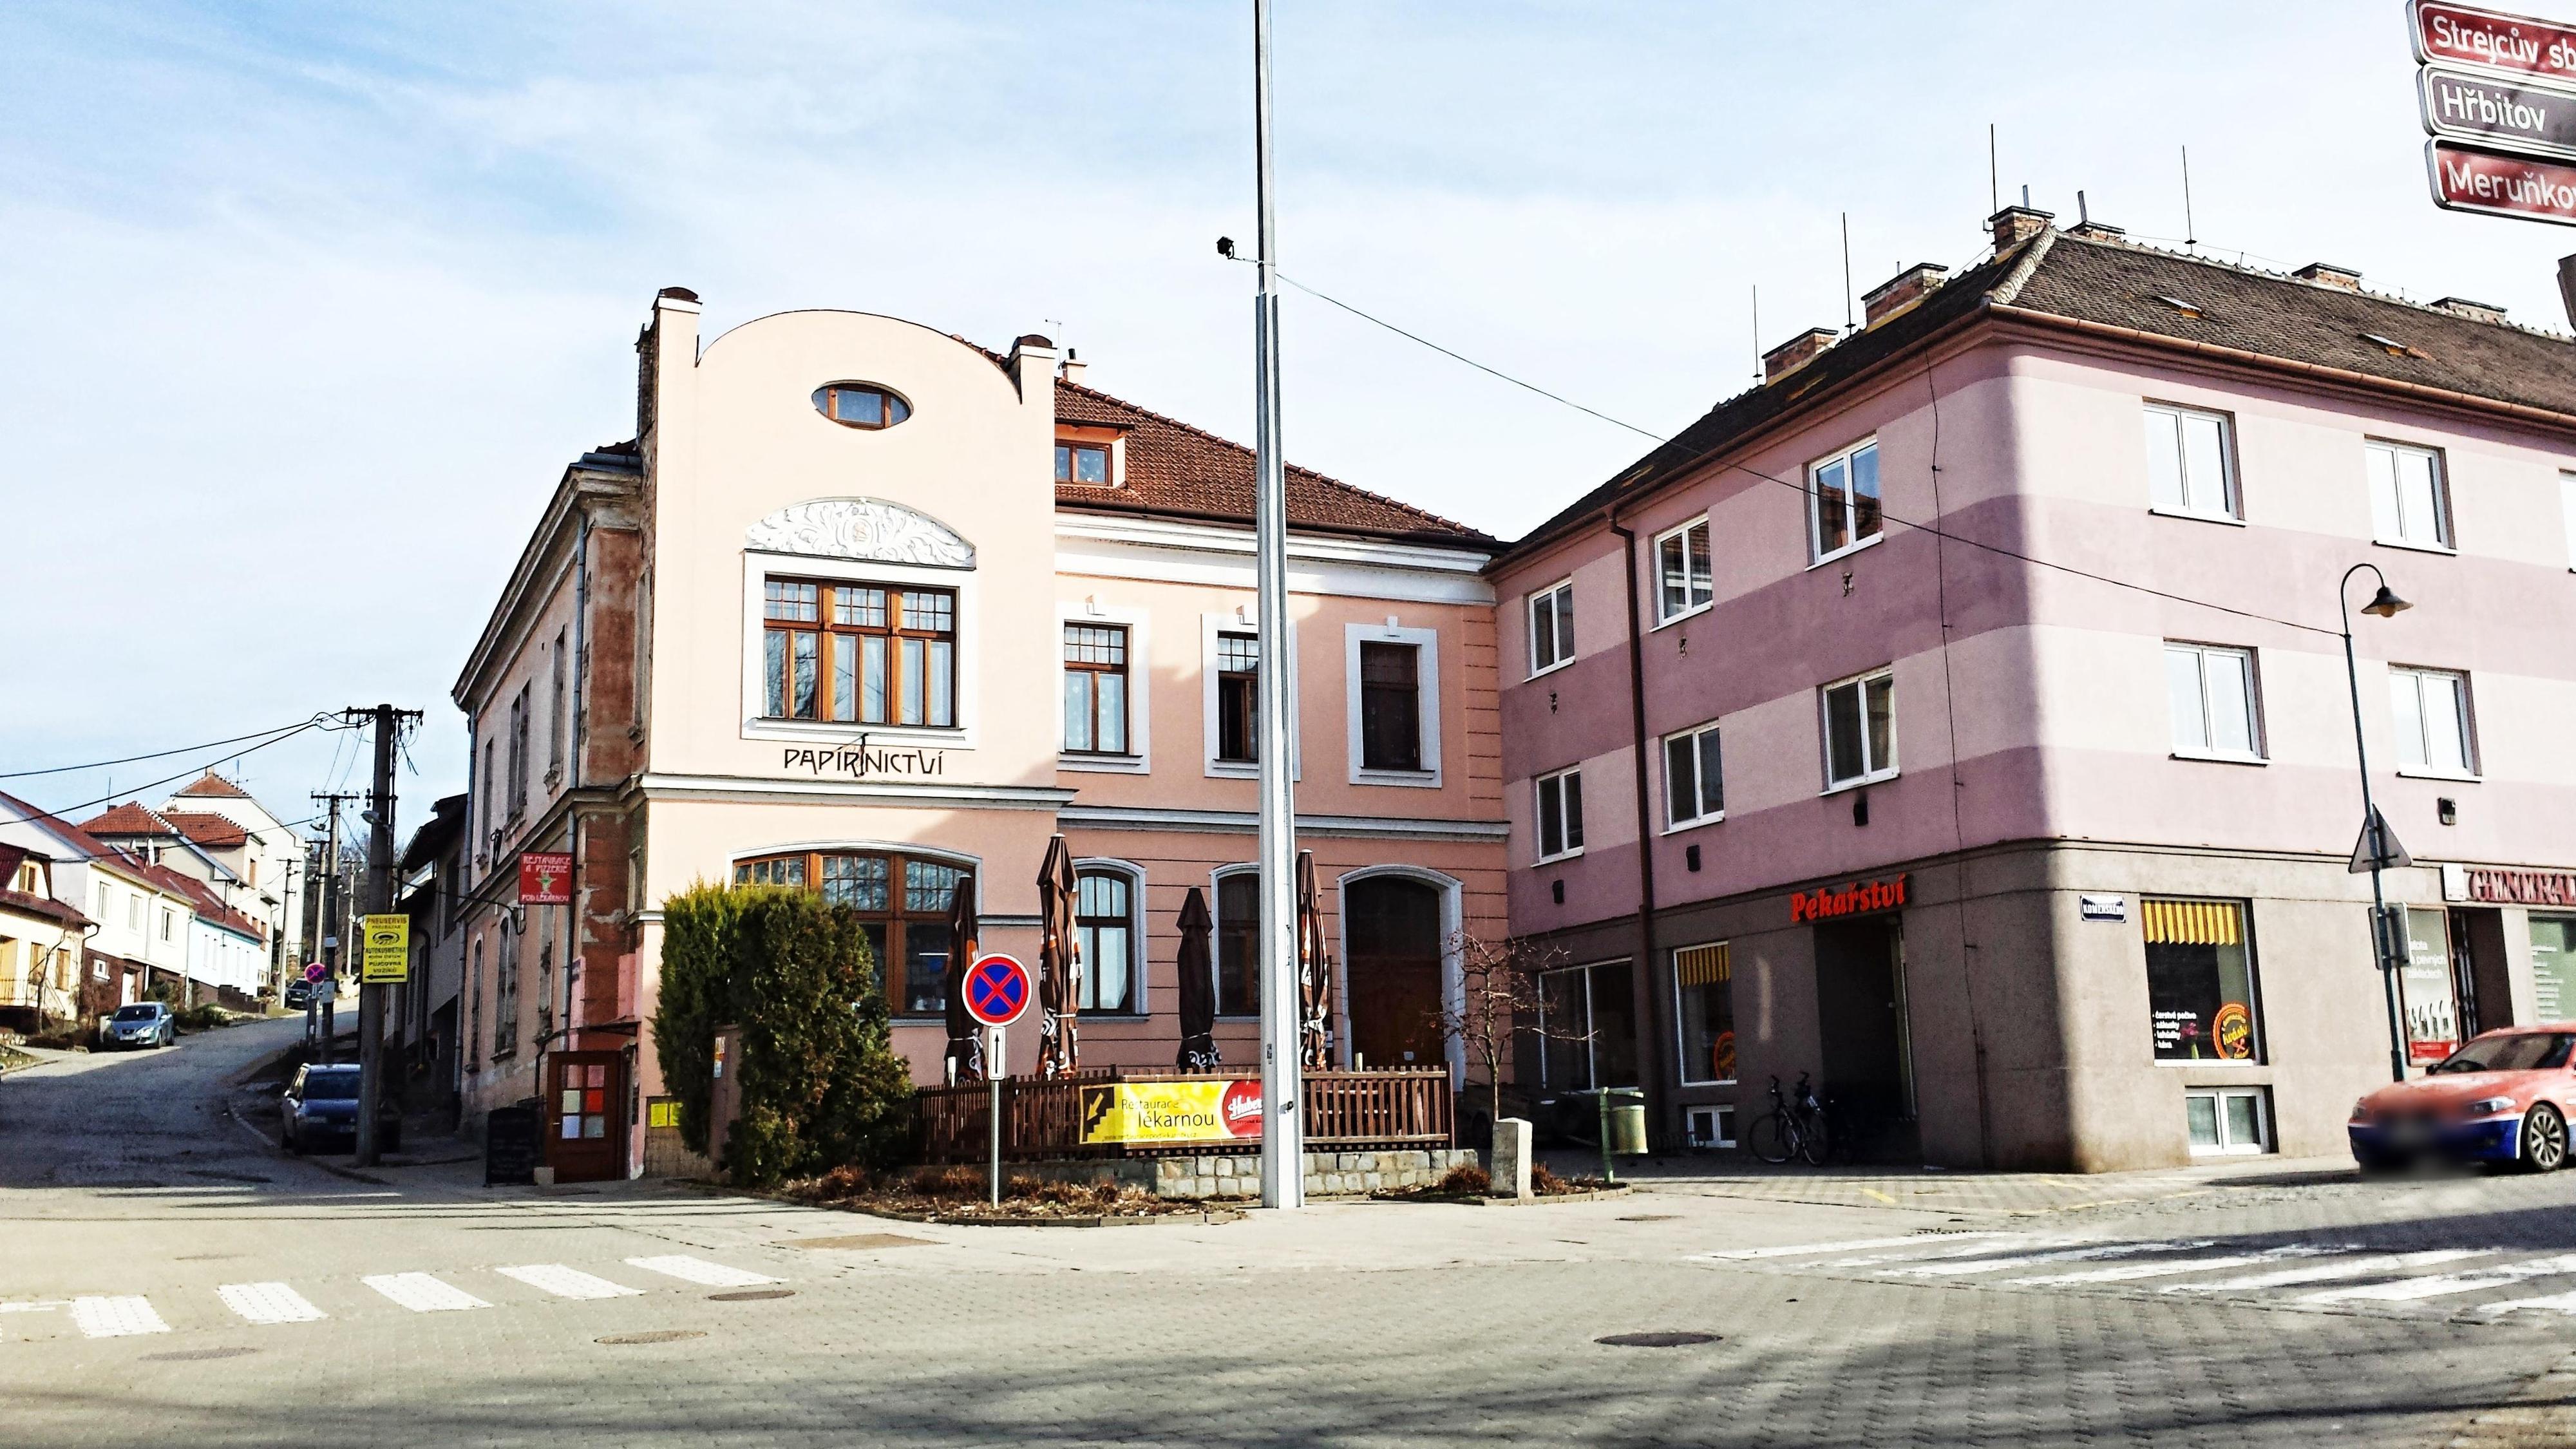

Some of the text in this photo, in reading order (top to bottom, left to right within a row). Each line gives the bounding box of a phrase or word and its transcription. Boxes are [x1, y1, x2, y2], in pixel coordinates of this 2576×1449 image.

[2432, 15, 2539, 64] Strejcův
[2441, 84, 2546, 132] Hřbitov
[523, 856, 571, 865] RESTAURACE
[1790, 872, 1906, 923] Pekařství
[1121, 1098, 1180, 1110] Restaurace
[1138, 1110, 1215, 1128] lékarnou
